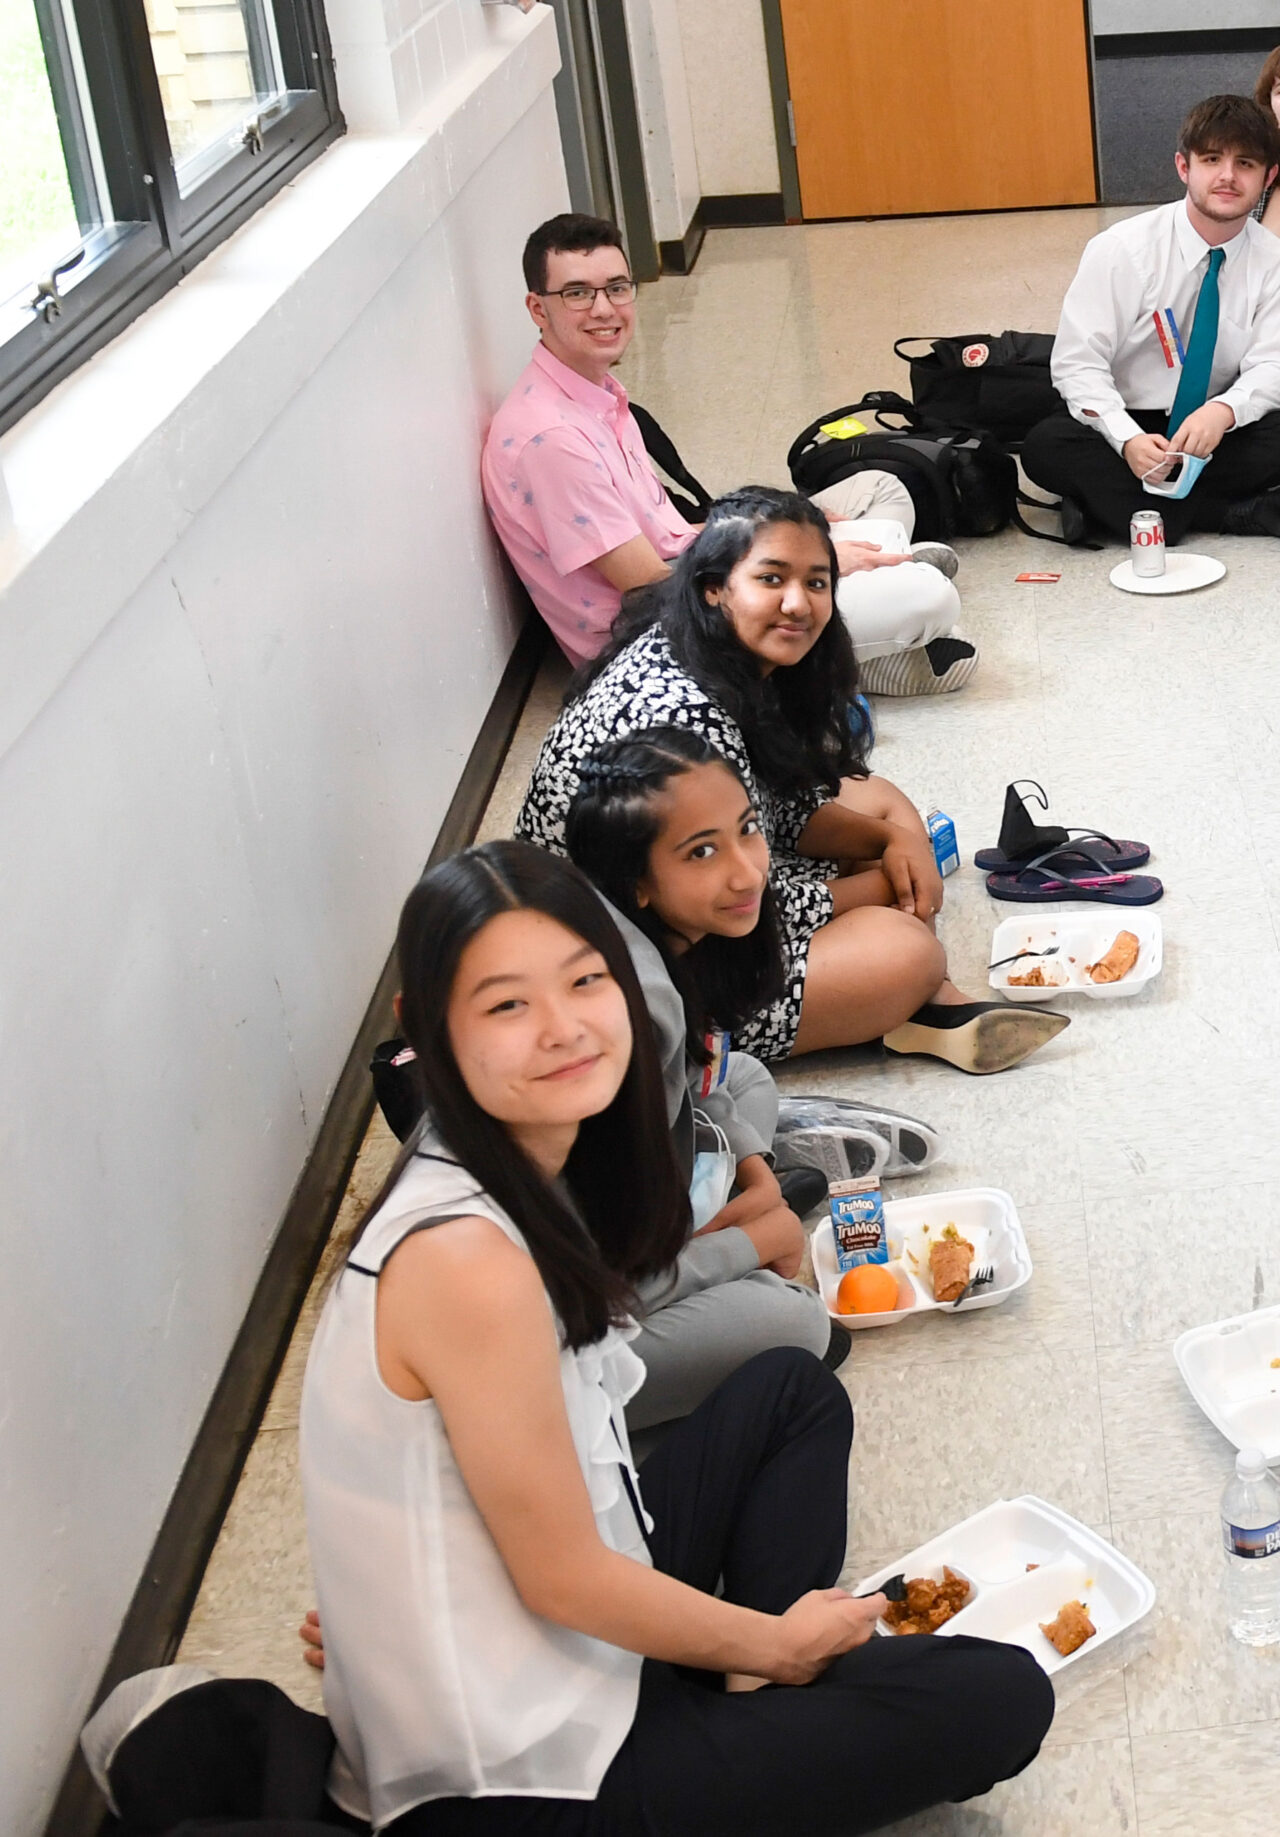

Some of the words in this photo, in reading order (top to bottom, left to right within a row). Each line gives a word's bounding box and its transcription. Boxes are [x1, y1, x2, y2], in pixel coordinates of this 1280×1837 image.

[1130, 522, 1165, 547] Cok
[838, 1199, 875, 1214] TruMoo
[836, 1222, 882, 1240] TruMoo
